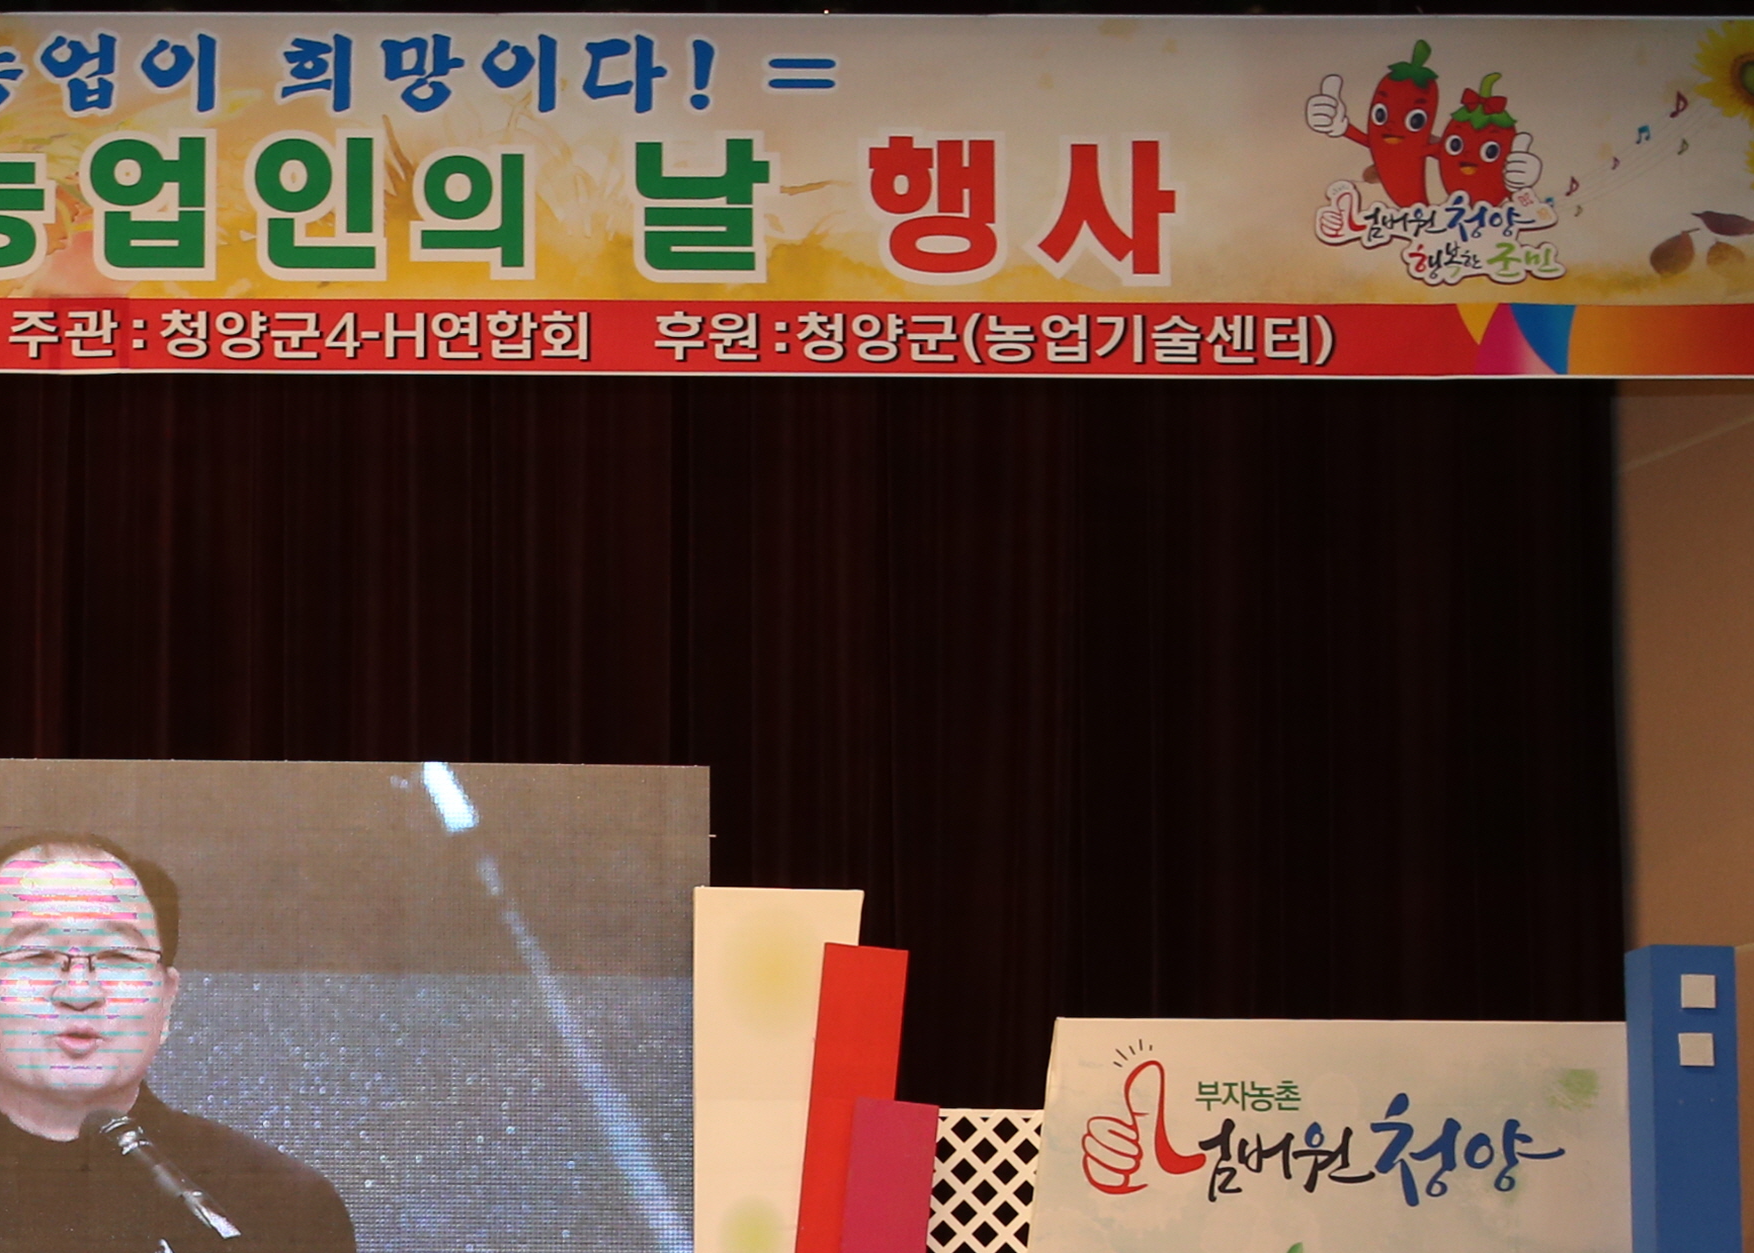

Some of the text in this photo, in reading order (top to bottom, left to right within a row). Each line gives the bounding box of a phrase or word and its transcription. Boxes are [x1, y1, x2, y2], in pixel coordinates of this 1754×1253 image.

[282, 34, 714, 113] 희망이다!
[634, 138, 770, 271] 날
[868, 136, 1176, 275] 행사
[1445, 195, 1535, 242] 청양
[1487, 242, 1560, 278] 군민
[1194, 1079, 1303, 1113] 부자농촌
[1370, 1092, 1566, 1207] 청양
